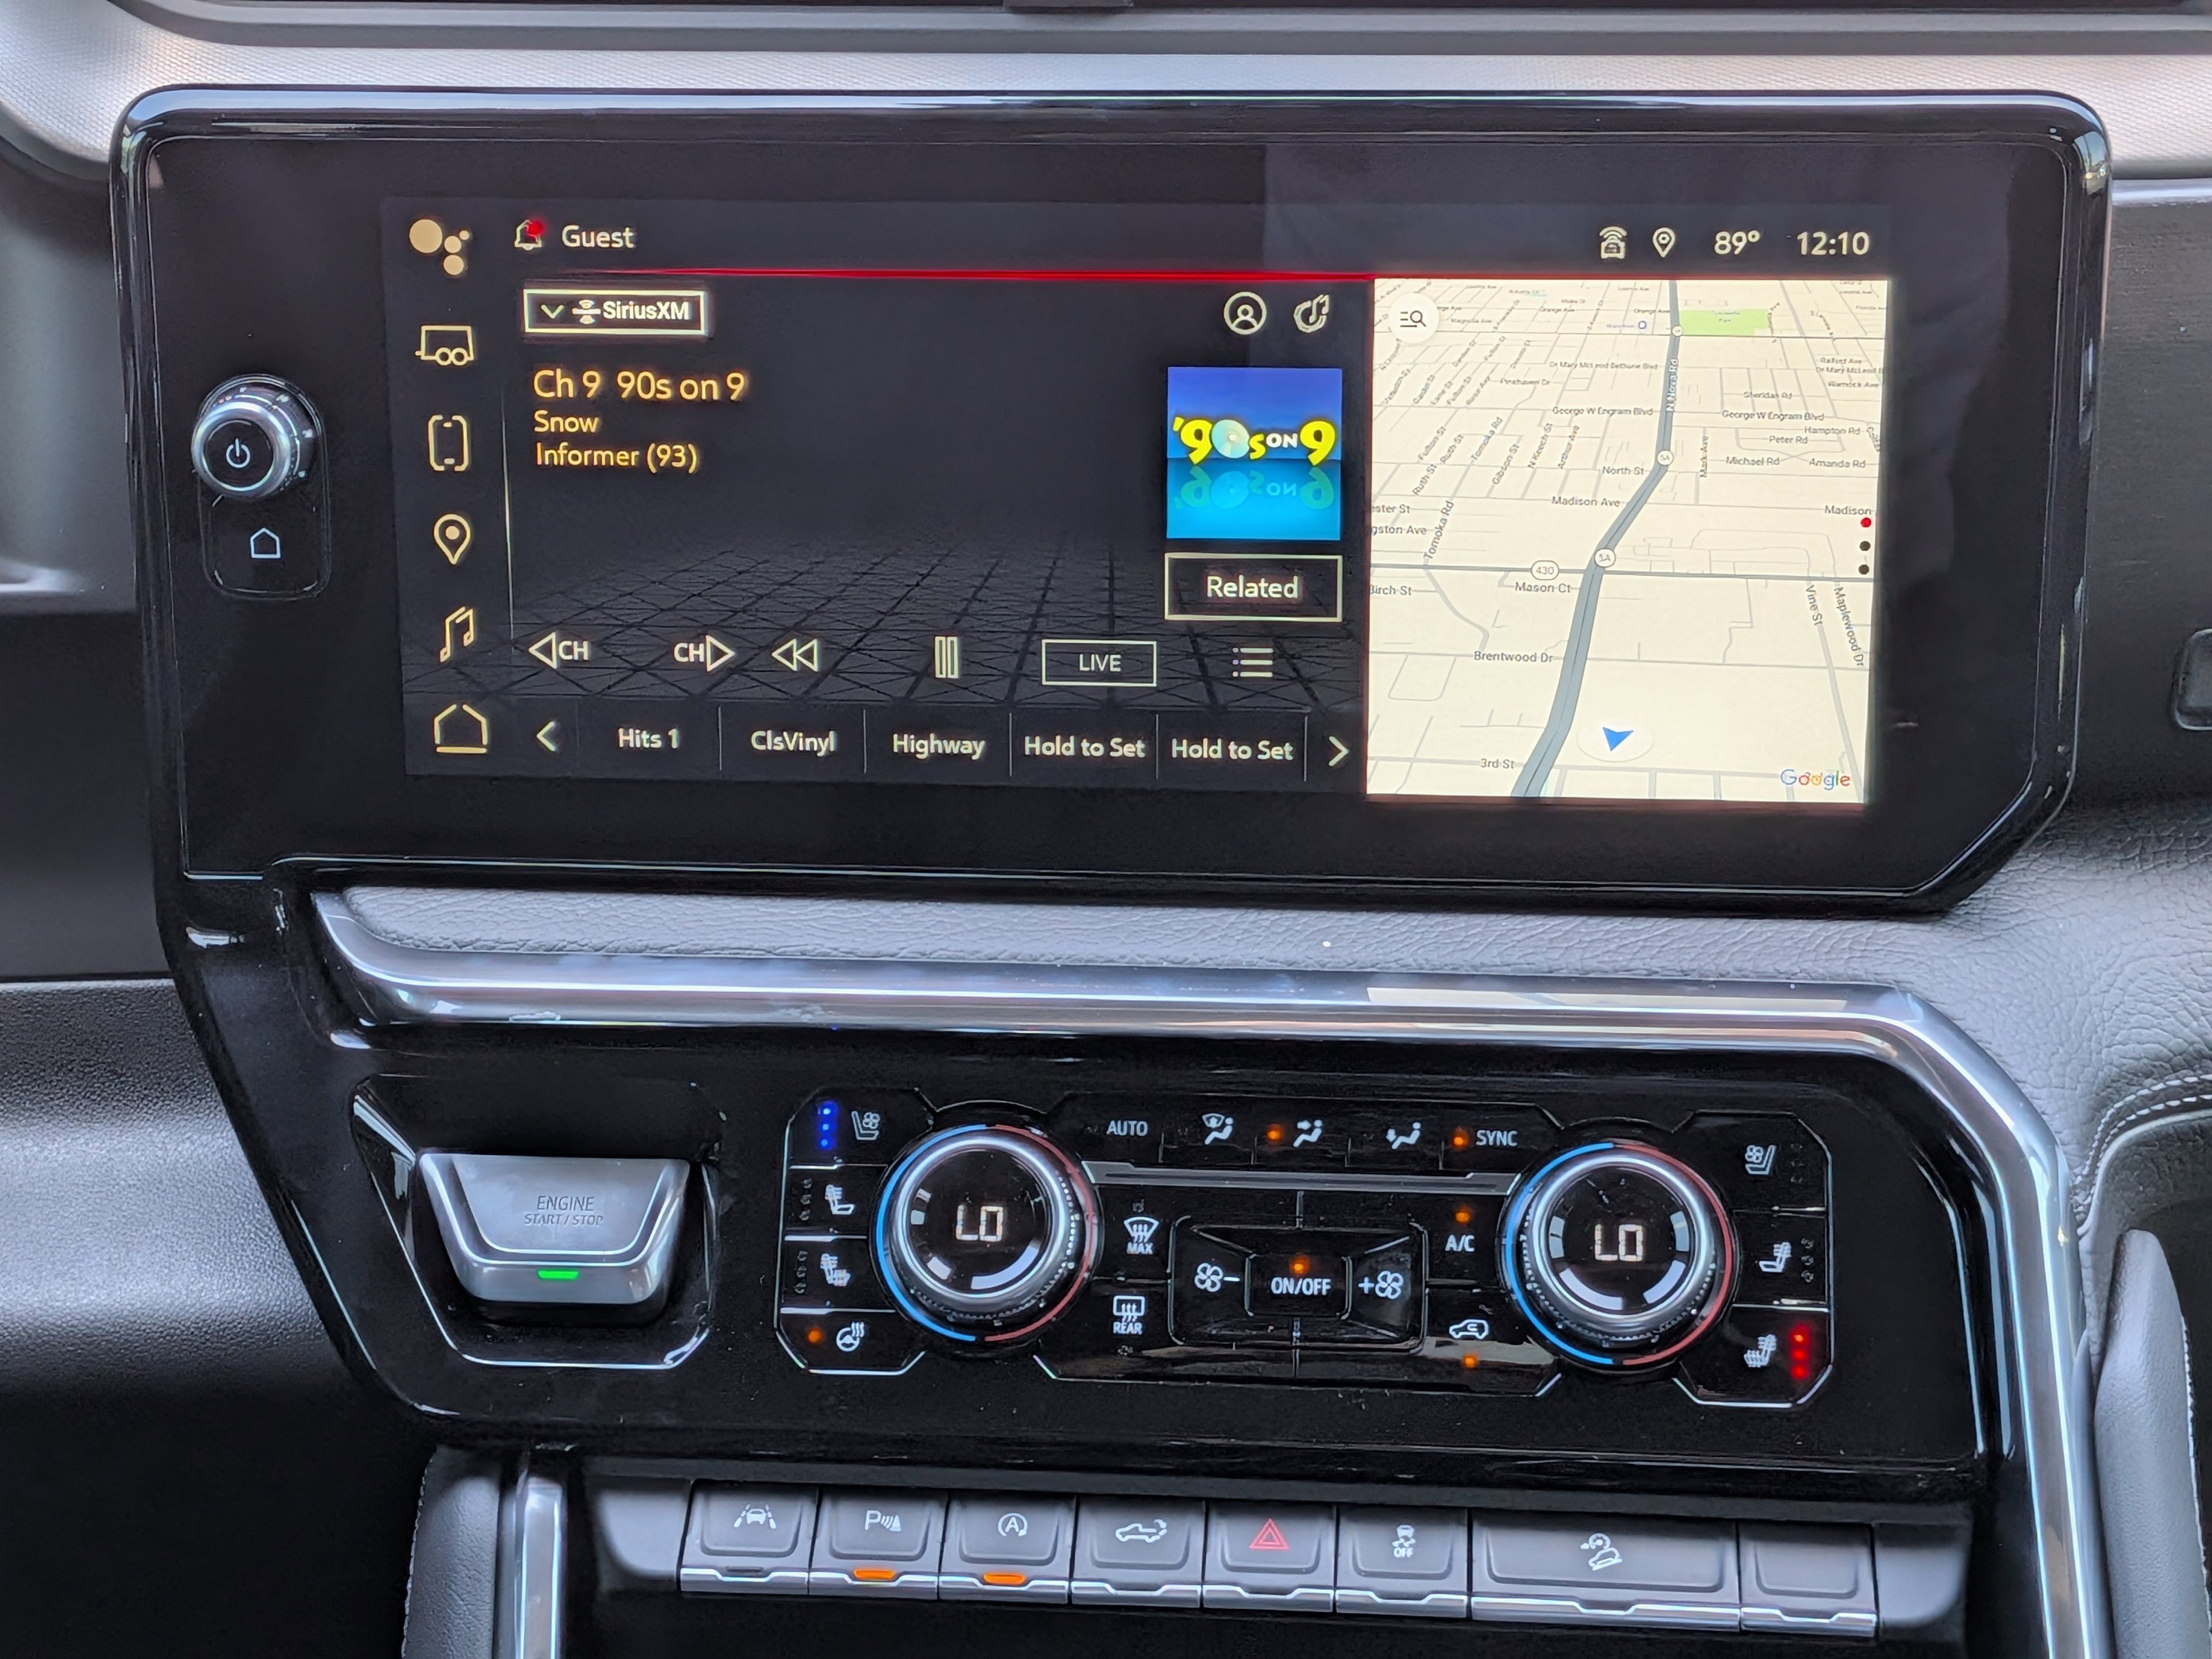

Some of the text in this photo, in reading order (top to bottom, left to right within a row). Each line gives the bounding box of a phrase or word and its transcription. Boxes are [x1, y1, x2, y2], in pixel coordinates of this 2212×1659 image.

[562, 225, 635, 248] Guest
[1797, 231, 1870, 255] 12:10
[603, 301, 690, 320] SiriusXM
[533, 369, 745, 400] Ch 9 90s on 9
[1552, 406, 1584, 415] George
[1722, 410, 1755, 420] George
[534, 410, 599, 434] Snow
[1491, 416, 1503, 430] Rd
[1804, 426, 1846, 436] Hampton
[1266, 432, 1298, 448] ON
[1300, 420, 1336, 466] 9
[1796, 436, 1808, 444] Rd
[1509, 444, 1520, 455] St
[536, 442, 698, 474] Informer (93)
[1527, 461, 1536, 469] N
[1726, 456, 1780, 466] Michael Rd
[1809, 458, 1866, 468] Amanda Rd
[1602, 466, 1644, 475] North St
[1412, 463, 1437, 495] Ruth St
[1399, 504, 1411, 514] St
[1551, 496, 1620, 507] Madison Ave
[1824, 505, 1872, 515] Madison
[1406, 525, 1427, 535] Ave
[1423, 500, 1454, 559] Tomoka Rd
[1536, 566, 1555, 576] 430
[1207, 576, 1299, 599] Related
[1400, 585, 1412, 596] St
[1515, 582, 1571, 593] Mason Ct
[1806, 585, 1823, 626] Vine St
[1833, 587, 1864, 666] Maplewood Dr
[558, 640, 589, 661] CH
[674, 642, 705, 663] CH
[1474, 651, 1553, 662] Brentwood Dr
[1079, 654, 1121, 672] LIVE
[618, 728, 679, 749] Hits 1
[751, 729, 836, 758] ClsVinyl
[893, 733, 986, 760] Highway
[1025, 735, 1146, 758] Hold to Set
[1171, 738, 1293, 761] Hold to Set
[1480, 758, 1515, 769] 3rd St
[1780, 769, 1850, 791] Google
[1107, 1120, 1148, 1137] AUTO
[1476, 1131, 1518, 1147] SYNC
[537, 1196, 595, 1212] ENGINE
[1126, 1242, 1153, 1255] MAX
[1445, 1235, 1475, 1253] A/C
[1271, 1277, 1332, 1296] ON/OFF
[1113, 1322, 1142, 1335] REAR
[1394, 1547, 1413, 1558] OFF
